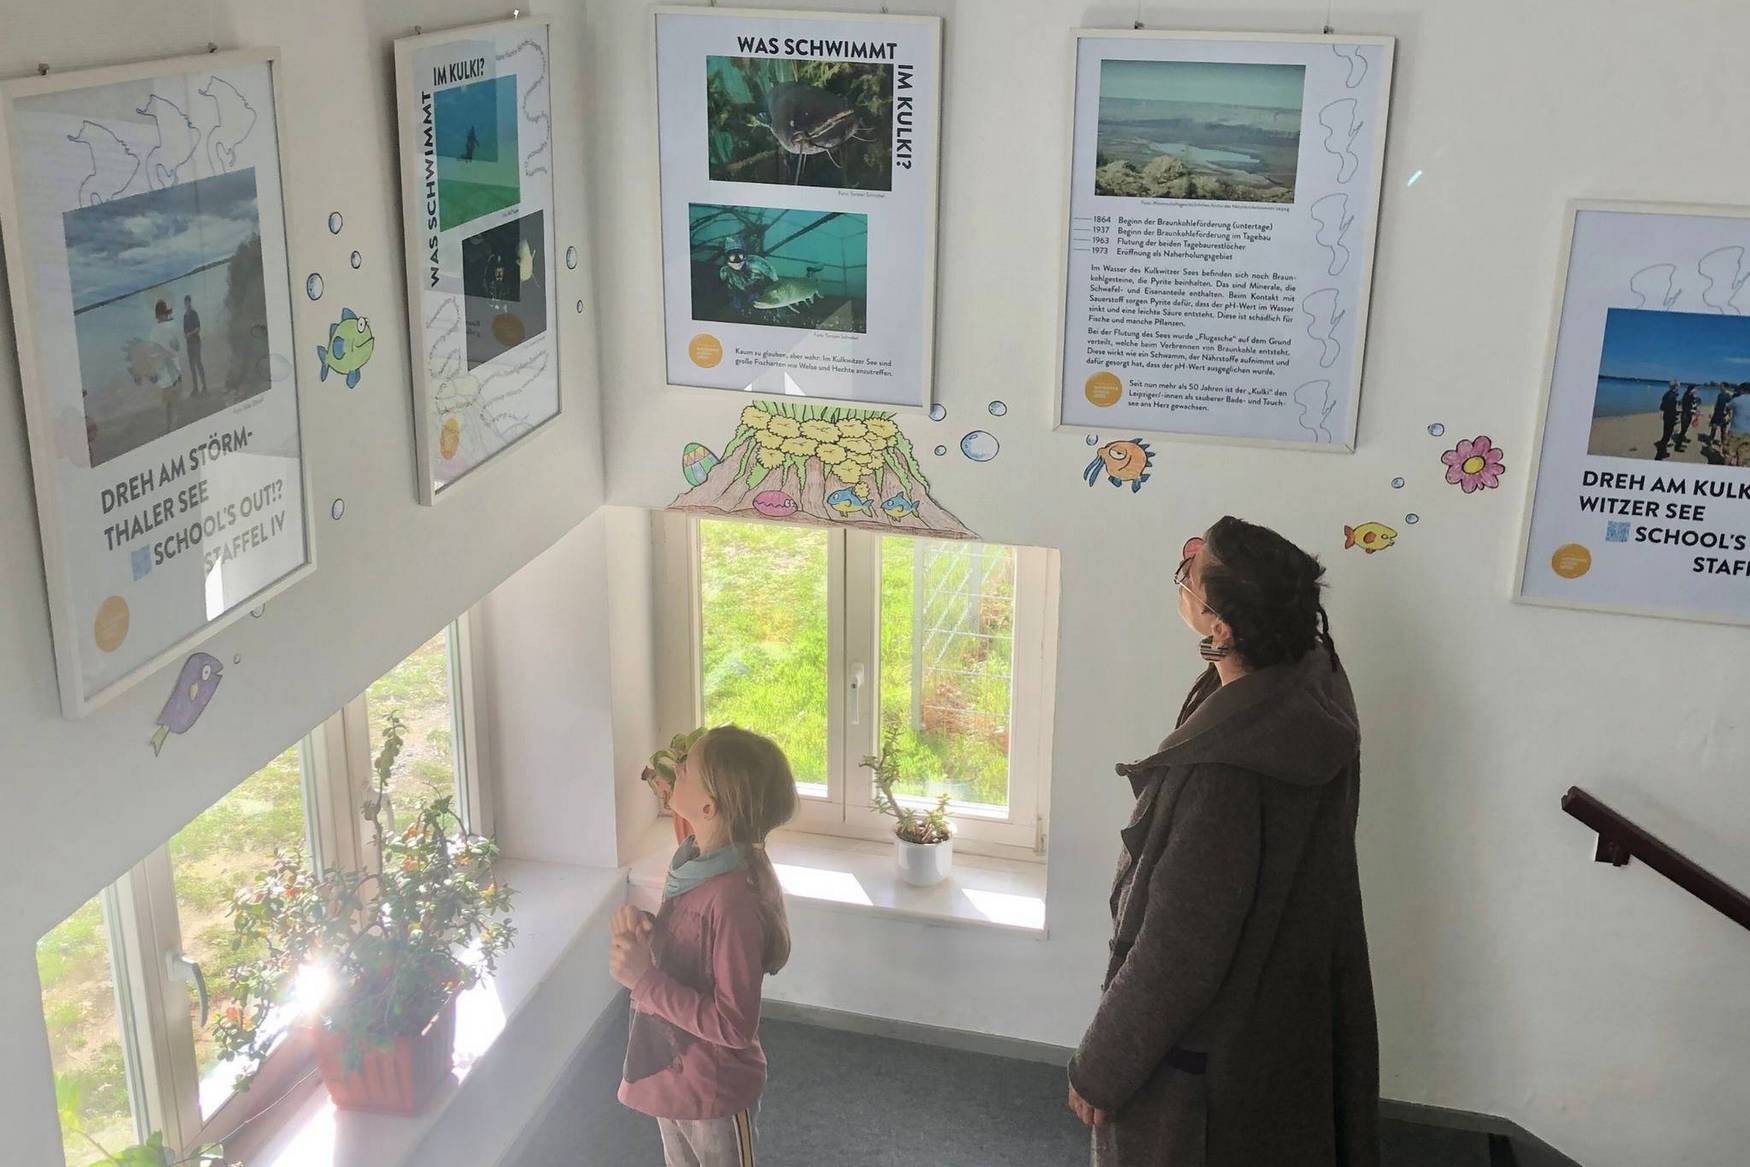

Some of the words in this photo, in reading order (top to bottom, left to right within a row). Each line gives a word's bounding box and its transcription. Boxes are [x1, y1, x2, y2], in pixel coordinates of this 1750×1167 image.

[738, 37, 778, 54] WAS
[784, 39, 897, 59] SCHWIMMT
[433, 67, 447, 86] IM
[450, 58, 485, 81] KULKI?
[898, 65, 913, 89] IM
[896, 97, 913, 170] KULKI?
[422, 91, 437, 230] SCHWIMMT
[1093, 215, 1111, 223] 1864
[1118, 216, 1142, 227] Beginn
[1144, 217, 1156, 225] der
[1232, 221, 1273, 233] (untertage)
[1093, 225, 1110, 233] 1937
[1118, 226, 1141, 237] Beginn
[1144, 227, 1155, 235] der
[1243, 232, 1271, 243] Tagebau
[1093, 236, 1110, 244] 1963
[1117, 237, 1144, 248] Flutung
[1145, 238, 1157, 246] der
[1158, 239, 1181, 247] beiden
[429, 235, 439, 287] WAS
[1092, 246, 1108, 254] 1973
[1152, 249, 1161, 257] als
[1163, 249, 1233, 262] Naherholungsgebiet
[1091, 263, 1100, 271] Im
[1103, 264, 1127, 272] Wasser
[1129, 265, 1141, 273] des
[1144, 266, 1179, 275] Kulkwitzer
[1183, 268, 1199, 276] Sees
[1202, 269, 1232, 278] befinden
[1235, 271, 1248, 279] sich
[1252, 272, 1269, 280] noch
[1273, 272, 1296, 281] Braun-
[1090, 284, 1123, 293] Schwefel-
[1127, 286, 1141, 294] und
[1144, 286, 1186, 296] Eisenanteile
[1189, 289, 1224, 298] enthalten.
[1229, 291, 1247, 299] Beim
[1251, 292, 1278, 301] Kontakt
[1283, 294, 1295, 302] mit
[1138, 276, 1147, 284] die
[1151, 276, 1172, 287] Pyrite
[1175, 278, 1213, 287] beinhalten.
[1216, 280, 1229, 288] Das
[1232, 281, 1246, 289] sind
[1249, 281, 1283, 292] Minerale,
[1285, 283, 1296, 291] die
[1090, 294, 1124, 303] Sauerstoff
[1126, 298, 1148, 307] sorgen
[1150, 297, 1171, 308] Pyrite
[1173, 298, 1193, 308] dafür,
[1195, 299, 1209, 308] dass
[1211, 300, 1222, 308] der
[1225, 301, 1256, 311] pH-Wert
[1270, 303, 1294, 312] Wasser
[1088, 314, 1110, 323] Fische
[1126, 317, 1153, 325] manche
[1154, 317, 1185, 327] Pflanzen.
[1089, 304, 1105, 312] sinkt
[1107, 305, 1120, 313] und
[1121, 306, 1136, 314] eine
[1138, 307, 1160, 315] leichte
[1184, 309, 1214, 318] entsteht.
[1217, 311, 1237, 319] Diese
[1238, 312, 1247, 320] ist
[1283, 314, 1293, 322] für
[1088, 326, 1099, 335] Bei
[1101, 327, 1112, 335] der
[1114, 328, 1140, 340] Flutung
[1141, 330, 1153, 338] des
[1155, 330, 1171, 339] Sees
[1172, 332, 1193, 340] wurde
[1251, 336, 1267, 344] dem
[1269, 337, 1291, 346] Grund
[1087, 346, 1106, 355] Diese
[1107, 348, 1124, 356] wirkt
[1125, 349, 1137, 357] wie
[1138, 350, 1149, 358] ein
[1150, 350, 1187, 361] Schwamm,
[1188, 352, 1200, 361] der
[1240, 356, 1274, 365] aufnimmt
[1276, 358, 1290, 366] und
[1115, 338, 1138, 347] welche
[1140, 339, 1157, 348] beim
[1160, 341, 1200, 350] Verbrennen
[1217, 344, 1256, 354] Braunkohle
[1259, 347, 1290, 356] entsteht.
[736, 347, 753, 355] Kaum
[832, 355, 865, 365] Kulkwitzer
[866, 358, 877, 366] See
[879, 359, 892, 367] sind
[1086, 356, 1103, 365] dafür
[1105, 359, 1130, 369] gesorgt
[1131, 359, 1144, 368] hat,
[1146, 360, 1160, 368] dass
[1162, 361, 1173, 369] der
[1174, 362, 1205, 372] pH-Wert
[1207, 365, 1250, 375] ausgeglichen
[1252, 367, 1275, 375] wurde.
[735, 358, 753, 367] große
[755, 359, 786, 368] Fischarten
[799, 362, 817, 370] Welse
[832, 365, 855, 373] Hechte
[856, 368, 893, 376] anzutreffen.
[1129, 379, 1143, 387] Seit
[1159, 381, 1176, 389] mehr
[1178, 382, 1187, 390] als
[1189, 383, 1199, 391] 50
[1200, 383, 1224, 392] Jahren
[1225, 385, 1233, 393] ist
[1235, 386, 1247, 394] der
[1274, 388, 1287, 396] den
[1185, 392, 1193, 400] als
[1195, 393, 1224, 402] sauberer
[1153, 400, 1170, 409] Herz
[1171, 402, 1208, 412] gewachsen.
[101, 469, 154, 514] DREH
[159, 456, 186, 487] AM
[189, 426, 252, 471] STÖRM-
[1583, 471, 1645, 491] DREH
[1650, 477, 1686, 494] AM
[1693, 480, 1750, 499] KULK
[104, 498, 175, 551] THALER
[179, 480, 209, 513] SEE
[1580, 496, 1660, 517] WITZER
[1665, 503, 1706, 521] SEE
[154, 507, 236, 566] SCHOOL'S
[240, 479, 283, 518] OUT!?
[271, 510, 286, 536] IV
[1635, 526, 1746, 550] SCHOOL'S
